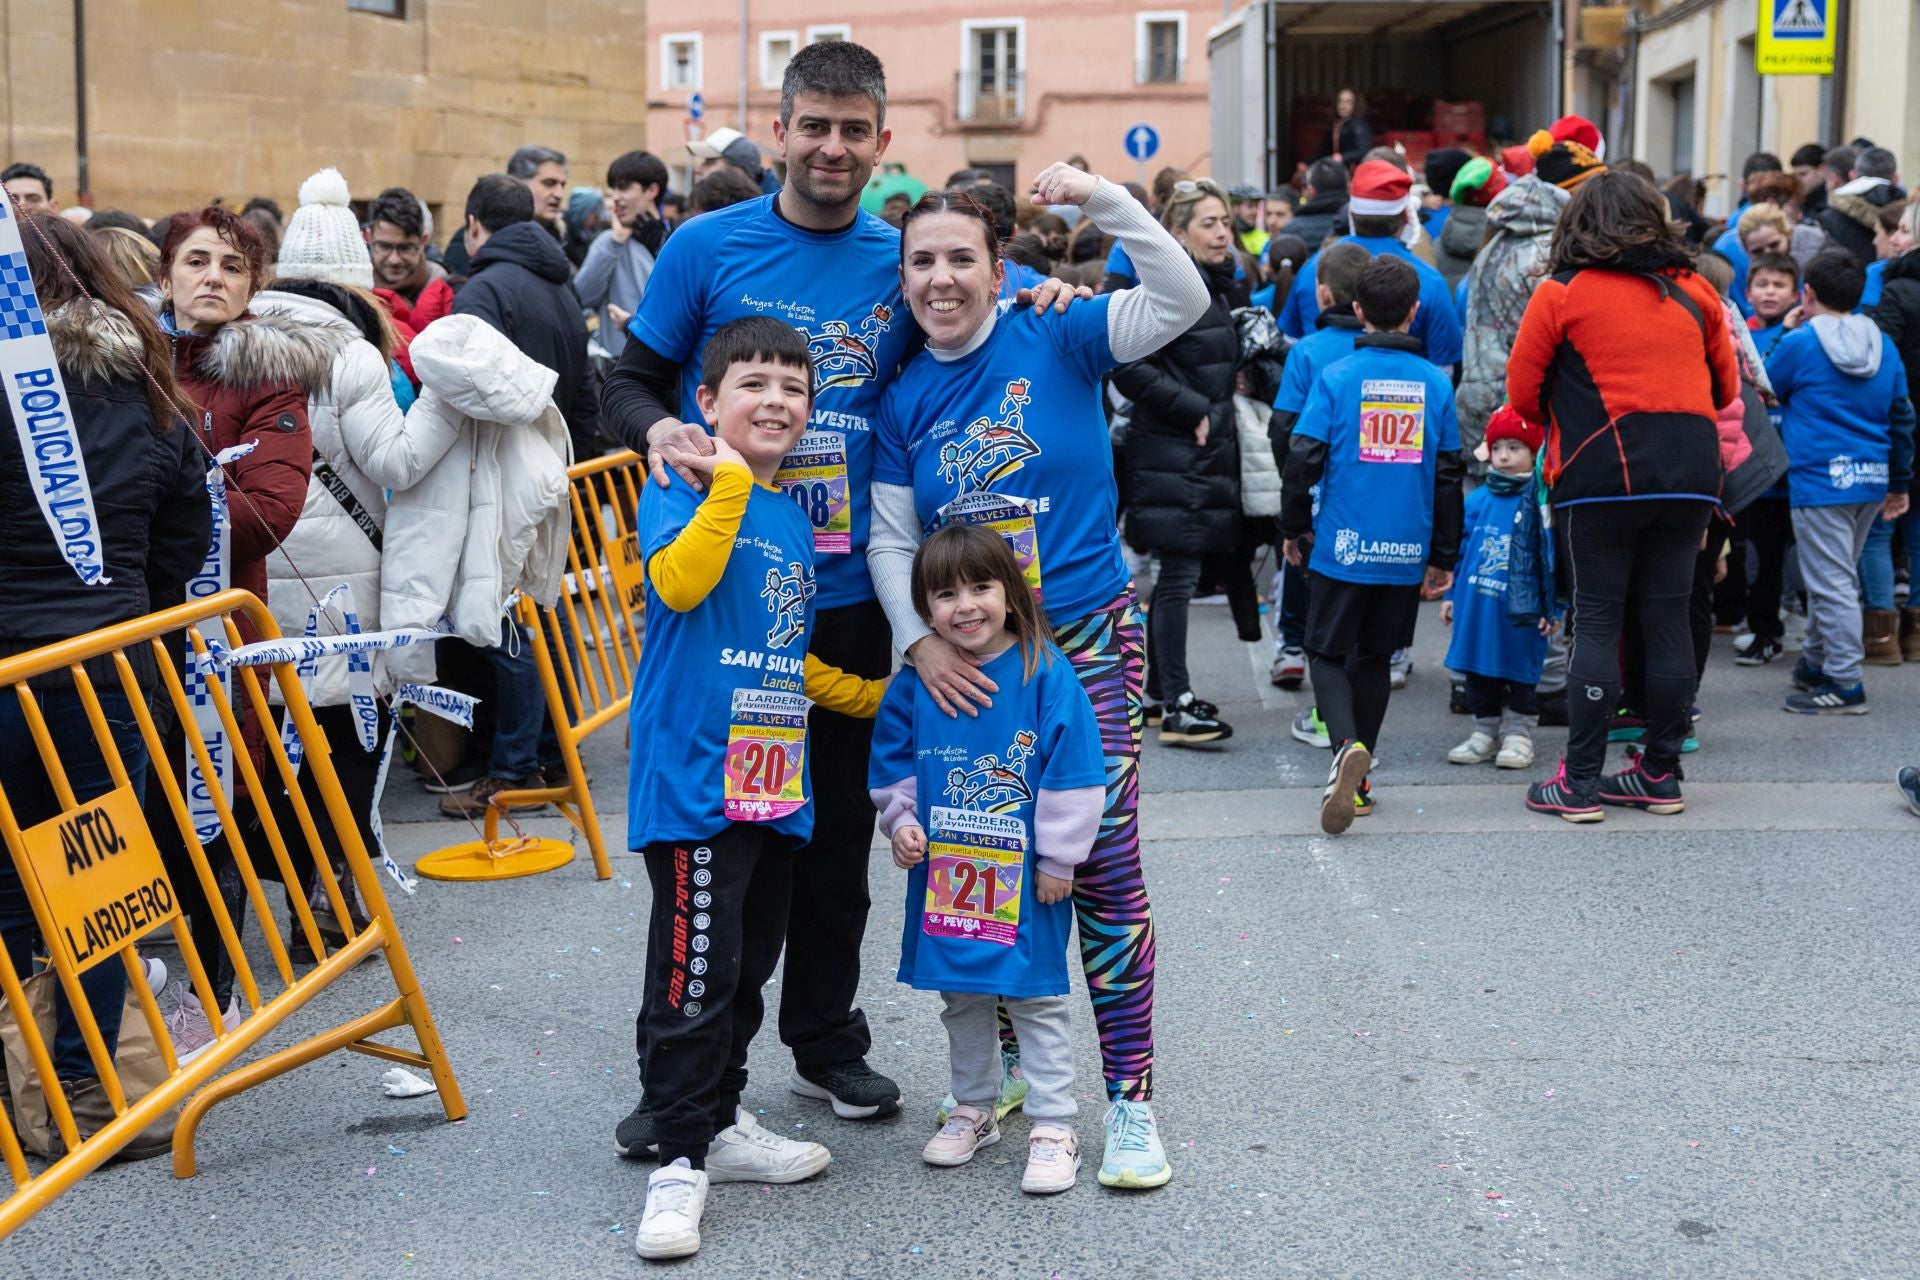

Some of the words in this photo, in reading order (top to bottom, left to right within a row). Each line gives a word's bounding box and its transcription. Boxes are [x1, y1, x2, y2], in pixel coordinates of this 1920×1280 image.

[1369, 413, 1415, 445] 102
[1361, 540, 1422, 556] LARDERO
[720, 647, 763, 669] SAN
[743, 701, 806, 712] ayuntamiento
[747, 693, 807, 706] LARDERO
[737, 712, 754, 722] SAN
[741, 741, 787, 796] 20
[740, 801, 773, 815] PEVISA
[944, 820, 1022, 835] ayuntamiento
[947, 812, 1020, 828] LARDERO
[938, 829, 957, 841] SAN
[930, 843, 948, 852] XVIII
[949, 846, 972, 855] vuelta
[973, 848, 1001, 859] Popular
[952, 860, 997, 915] 21
[65, 877, 173, 963] LARDERO
[943, 915, 981, 932] PEVISA
